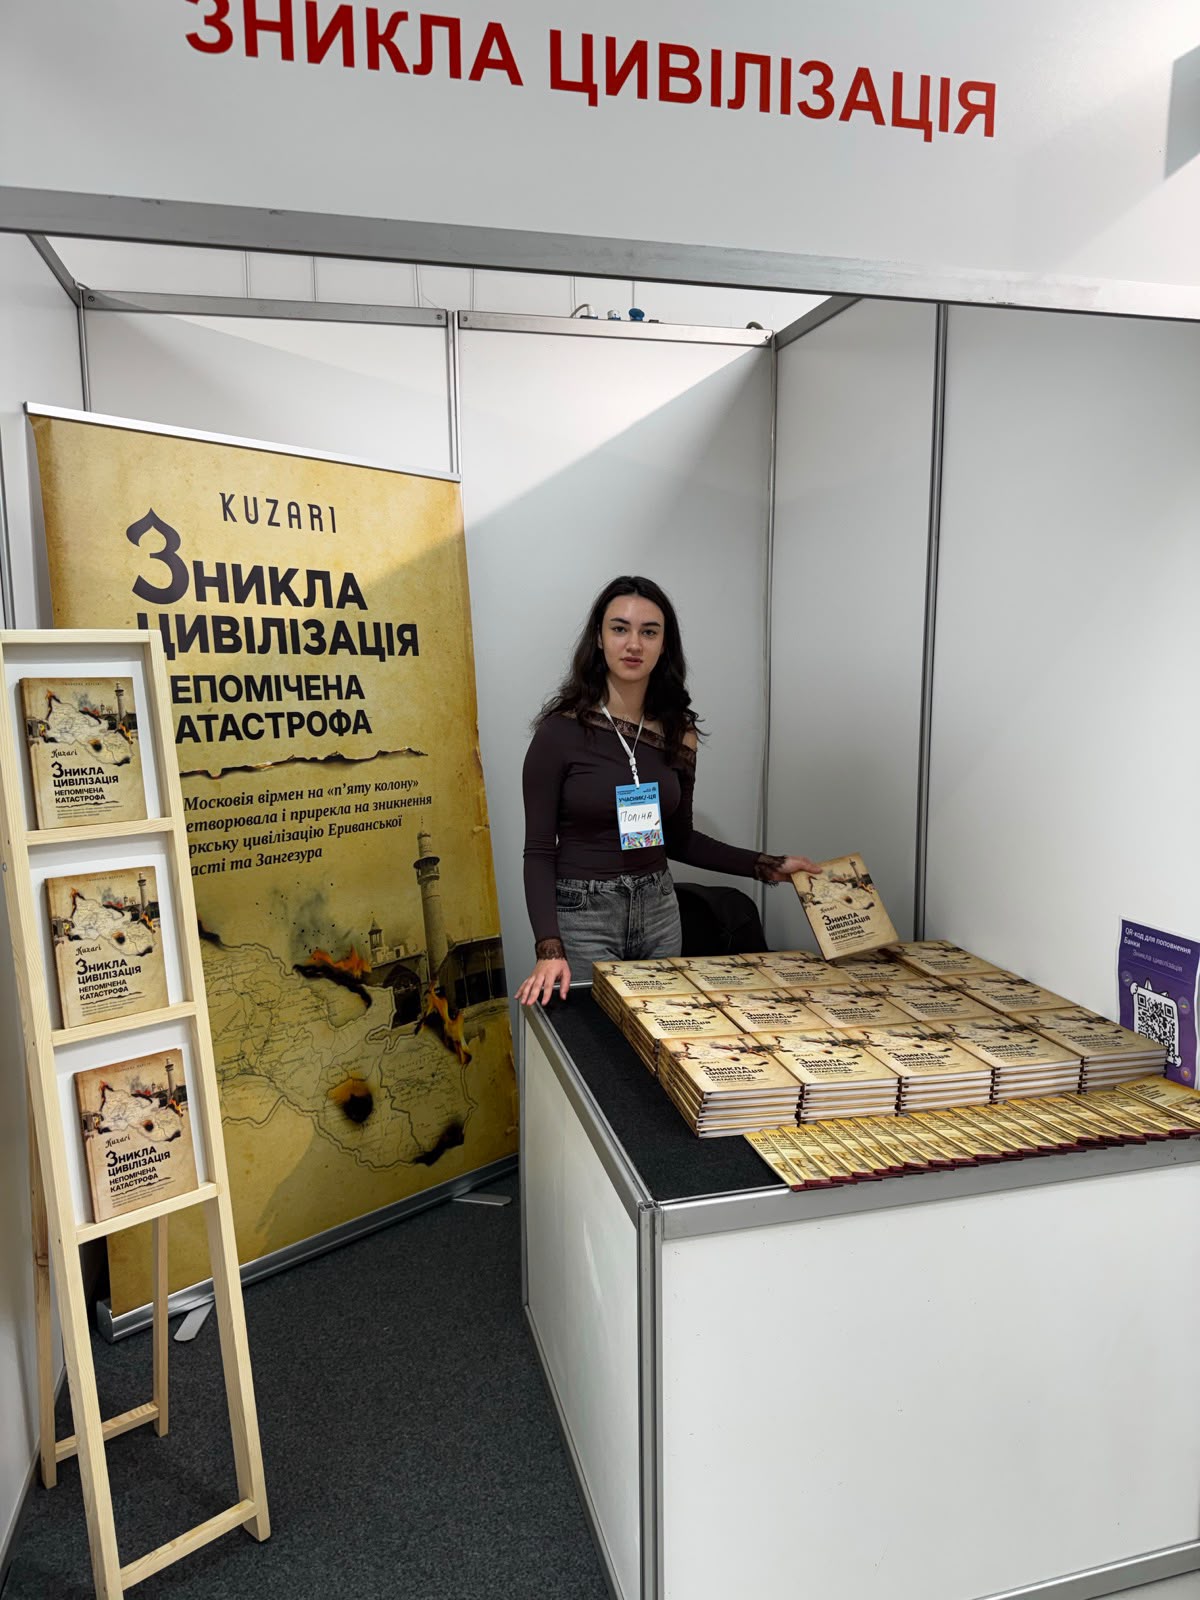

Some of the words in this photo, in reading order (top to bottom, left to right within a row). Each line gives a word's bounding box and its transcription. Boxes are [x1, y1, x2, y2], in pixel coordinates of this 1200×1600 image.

[185, 0, 524, 87] ЗНИКЛА
[549, 28, 996, 143] ЦИВІЛІЗАЦІЯ
[219, 492, 337, 533] KUZARI
[137, 612, 420, 662] ЦИВІЛІЗАЦІЯ
[169, 674, 366, 704] ЕПОМІЧЕНА
[174, 709, 373, 744] АТАСТРОФА
[53, 775, 119, 788] ЦИВІЛІЗАЦІЯ
[54, 787, 104, 796] НЕПОМІЧЕНА
[55, 794, 106, 804] КАТАСТРОФА
[184, 792, 254, 812] Московія
[258, 788, 304, 806] вірмен
[307, 786, 324, 798] на
[374, 778, 420, 794] колону»
[186, 812, 278, 833] етворювала
[281, 808, 287, 822] і
[290, 804, 351, 824] прирекла
[354, 801, 370, 814] на
[372, 795, 433, 811] зникнення
[188, 837, 239, 858] ркську
[243, 827, 325, 850] цивілізацію
[328, 815, 403, 837] Ериванської
[190, 858, 226, 877] асті
[230, 858, 252, 872] та
[255, 846, 323, 867] Зангезура
[1124, 936, 1141, 949] Банки
[1125, 928, 1144, 941] QR-код
[1156, 938, 1191, 954] поповнення
[78, 965, 142, 985] ЦИВІЛІЗАЦІЯ
[79, 979, 127, 994] НЕПОМІЧЕНА
[80, 986, 129, 1001] КАТАСТРОФА
[108, 1151, 171, 1177] ЦИВІЛІЗАЦІЯ
[109, 1166, 157, 1186] НЕПОМІЧЕНА
[110, 1173, 158, 1193] КАТАСТРОФА
